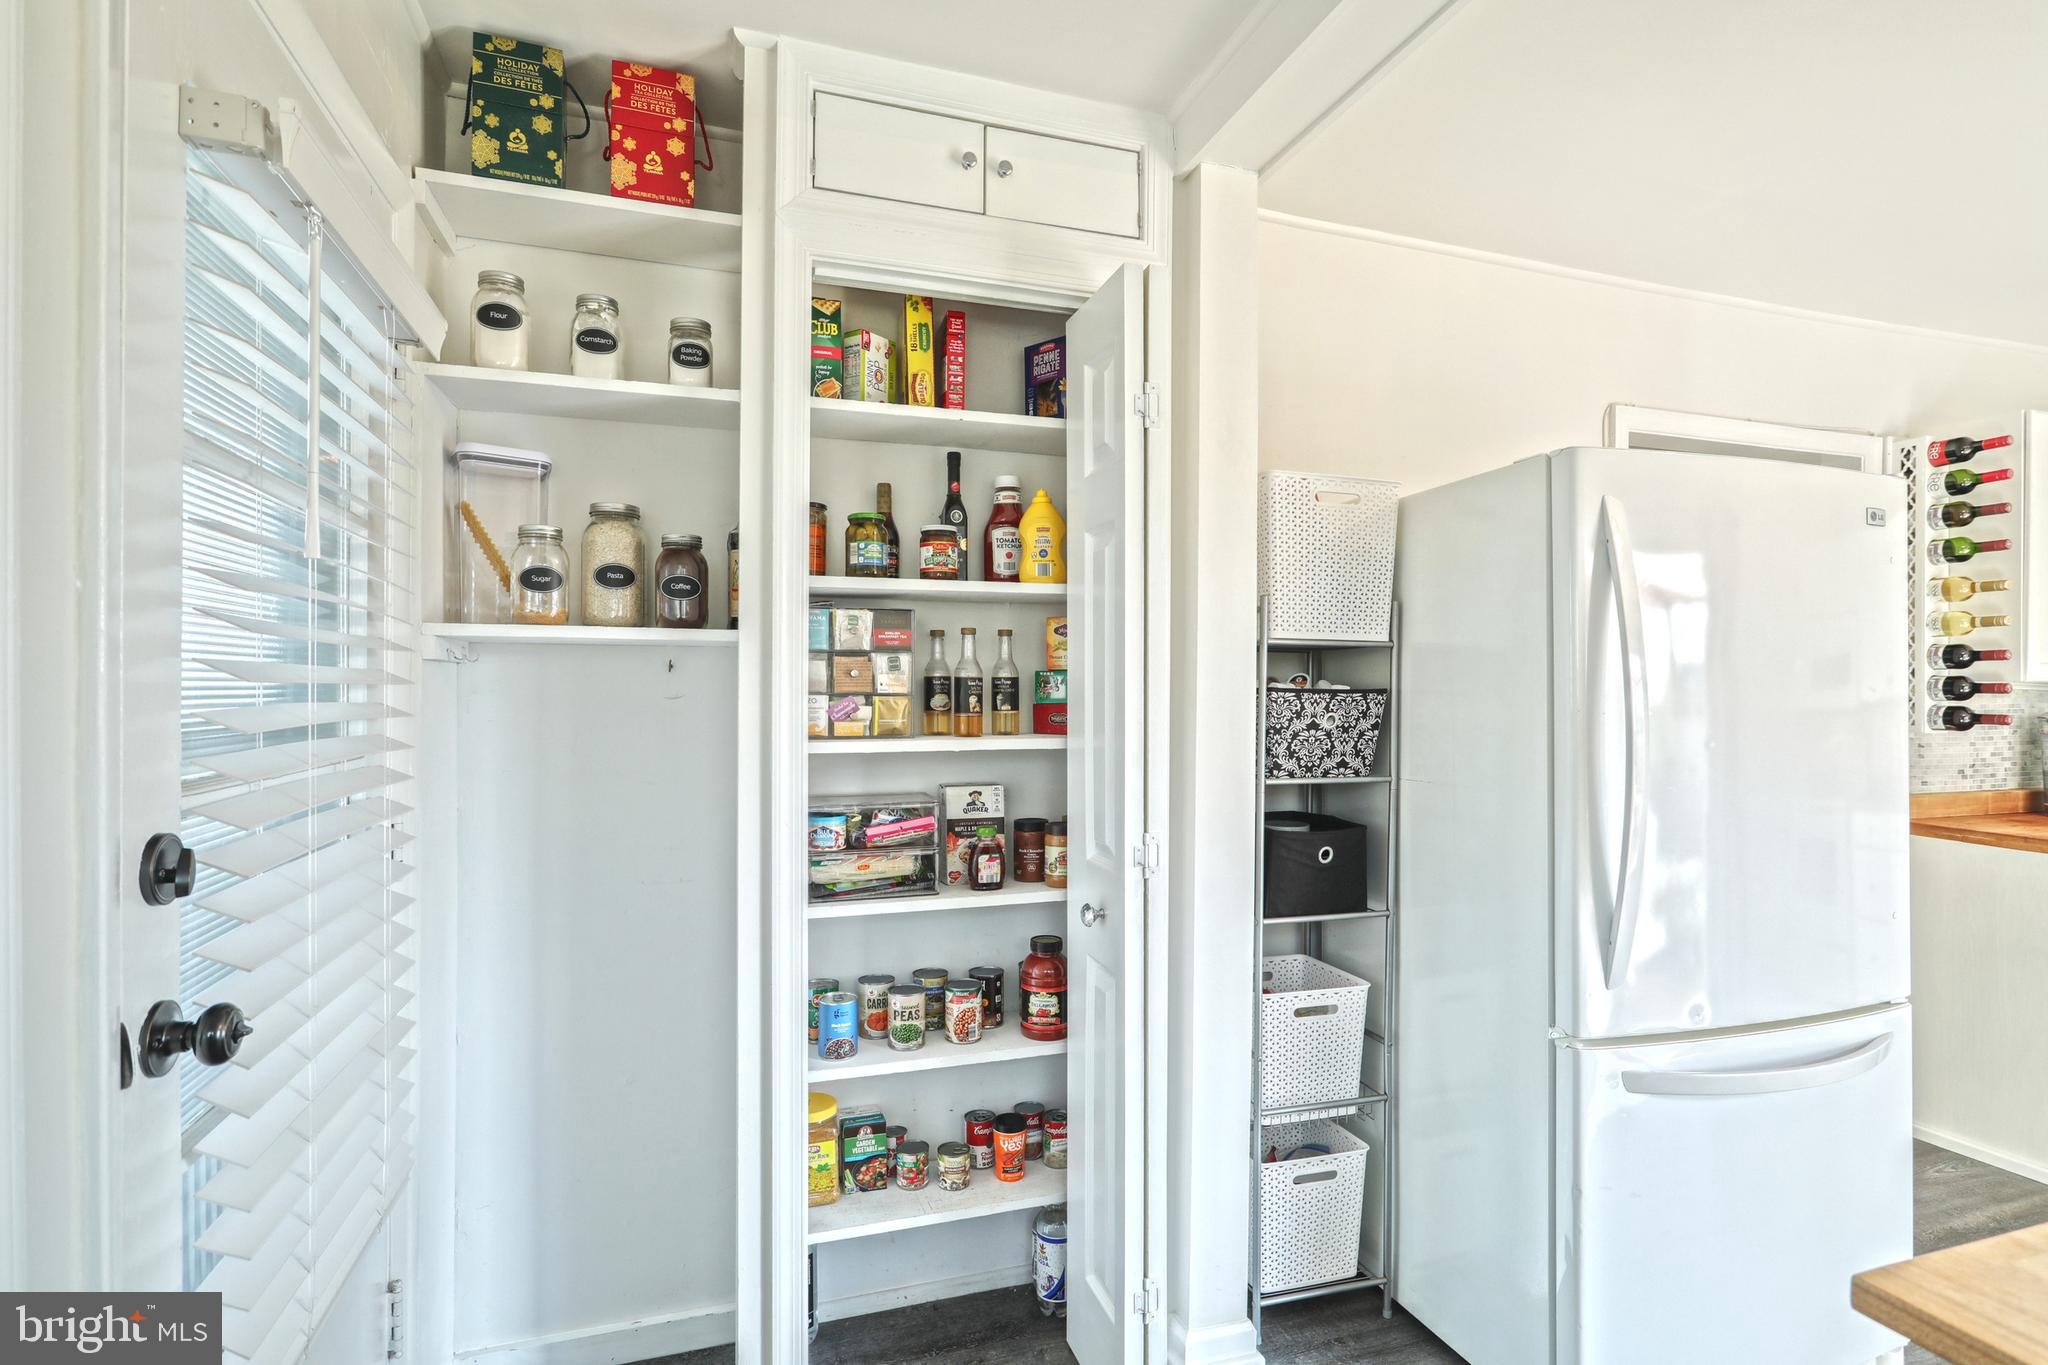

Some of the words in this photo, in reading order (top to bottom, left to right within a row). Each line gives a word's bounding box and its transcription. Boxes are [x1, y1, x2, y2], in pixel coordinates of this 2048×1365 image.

[497, 57, 540, 72] HOLIDAY
[508, 66, 540, 76] COLLECTION
[493, 76, 512, 86] DES
[634, 83, 674, 97] HOLIDAY
[644, 91, 673, 100] COLLECTION
[630, 100, 648, 110] DES
[489, 310, 508, 320] Flour
[811, 320, 839, 336] CLUB
[579, 334, 614, 346] Cornstarch
[680, 346, 702, 356] Baking
[910, 342, 918, 352] 18
[680, 353, 703, 363] Powder
[1033, 348, 1061, 367] PENNE
[1033, 360, 1061, 377] RIGATE
[531, 574, 552, 584] Sugar
[606, 572, 624, 580] Pasta
[670, 582, 691, 591] Coffee
[962, 806, 989, 815] QUAKER
[893, 1009, 921, 1022] PEAS
[851, 1144, 878, 1154] VEGETABLE
